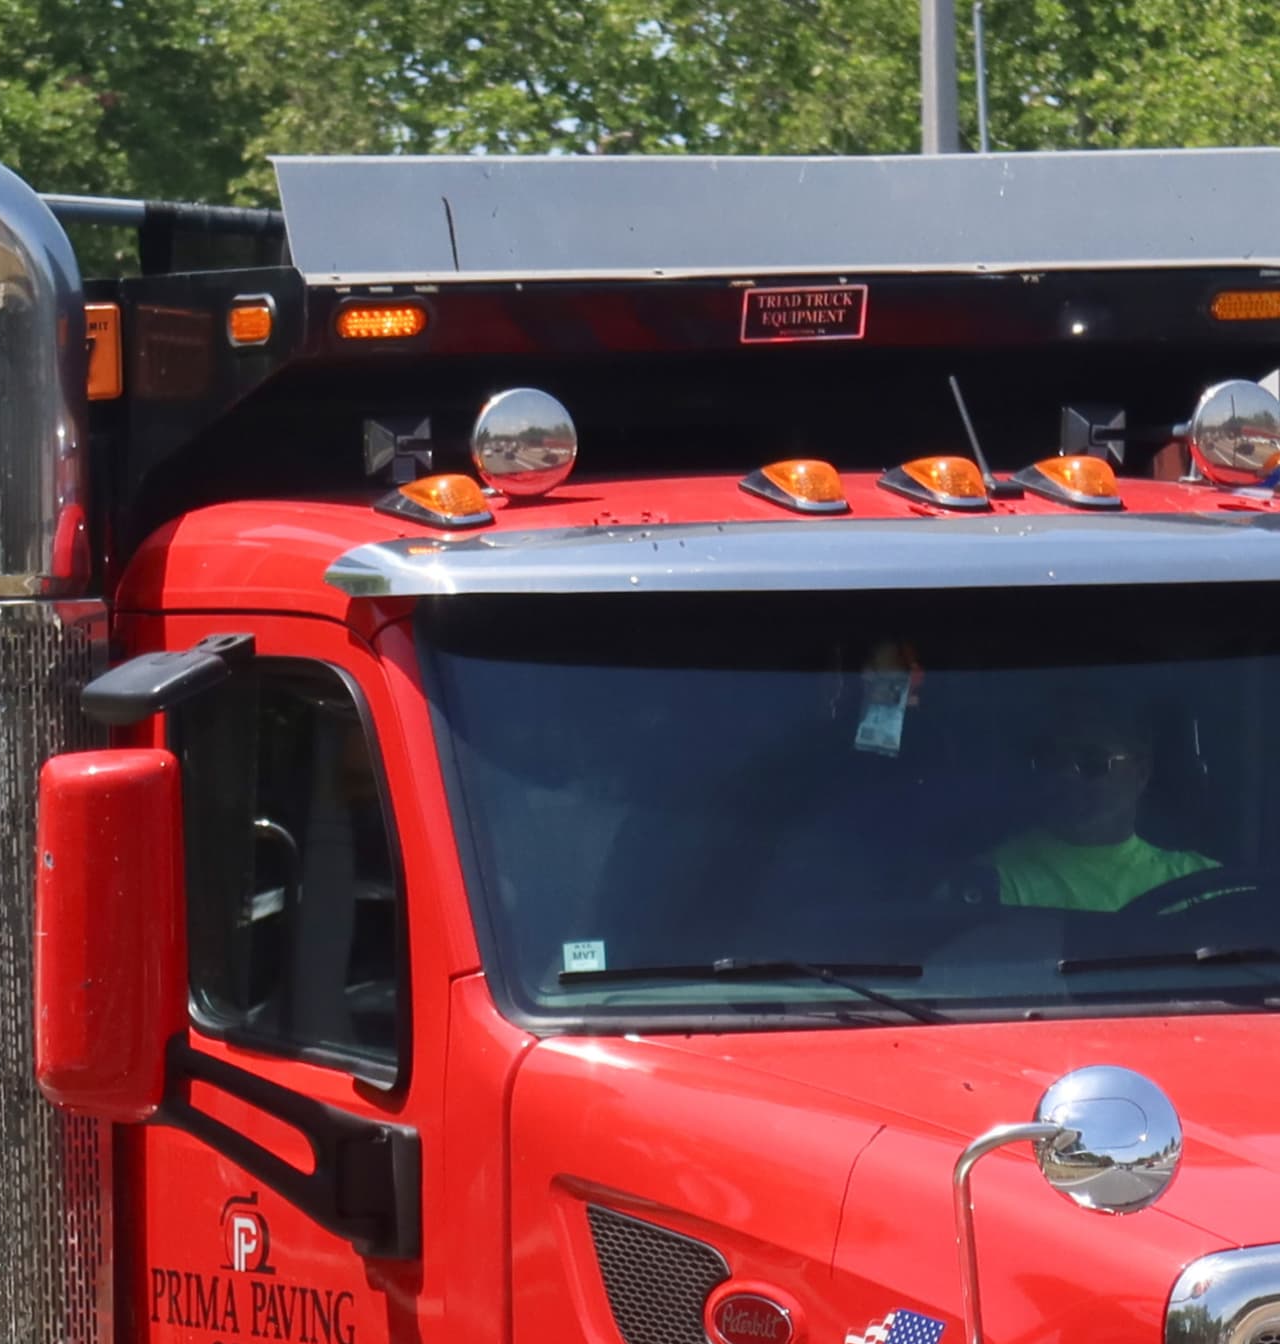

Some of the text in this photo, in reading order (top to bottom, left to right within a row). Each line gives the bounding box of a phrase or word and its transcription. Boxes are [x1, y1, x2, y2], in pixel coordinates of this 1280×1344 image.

[758, 292, 853, 308] TRIAD TRUCK
[761, 309, 846, 327] EQUIPMENT
[150, 1267, 241, 1334] PRIMA
[721, 1303, 784, 1338] Peterbilt
